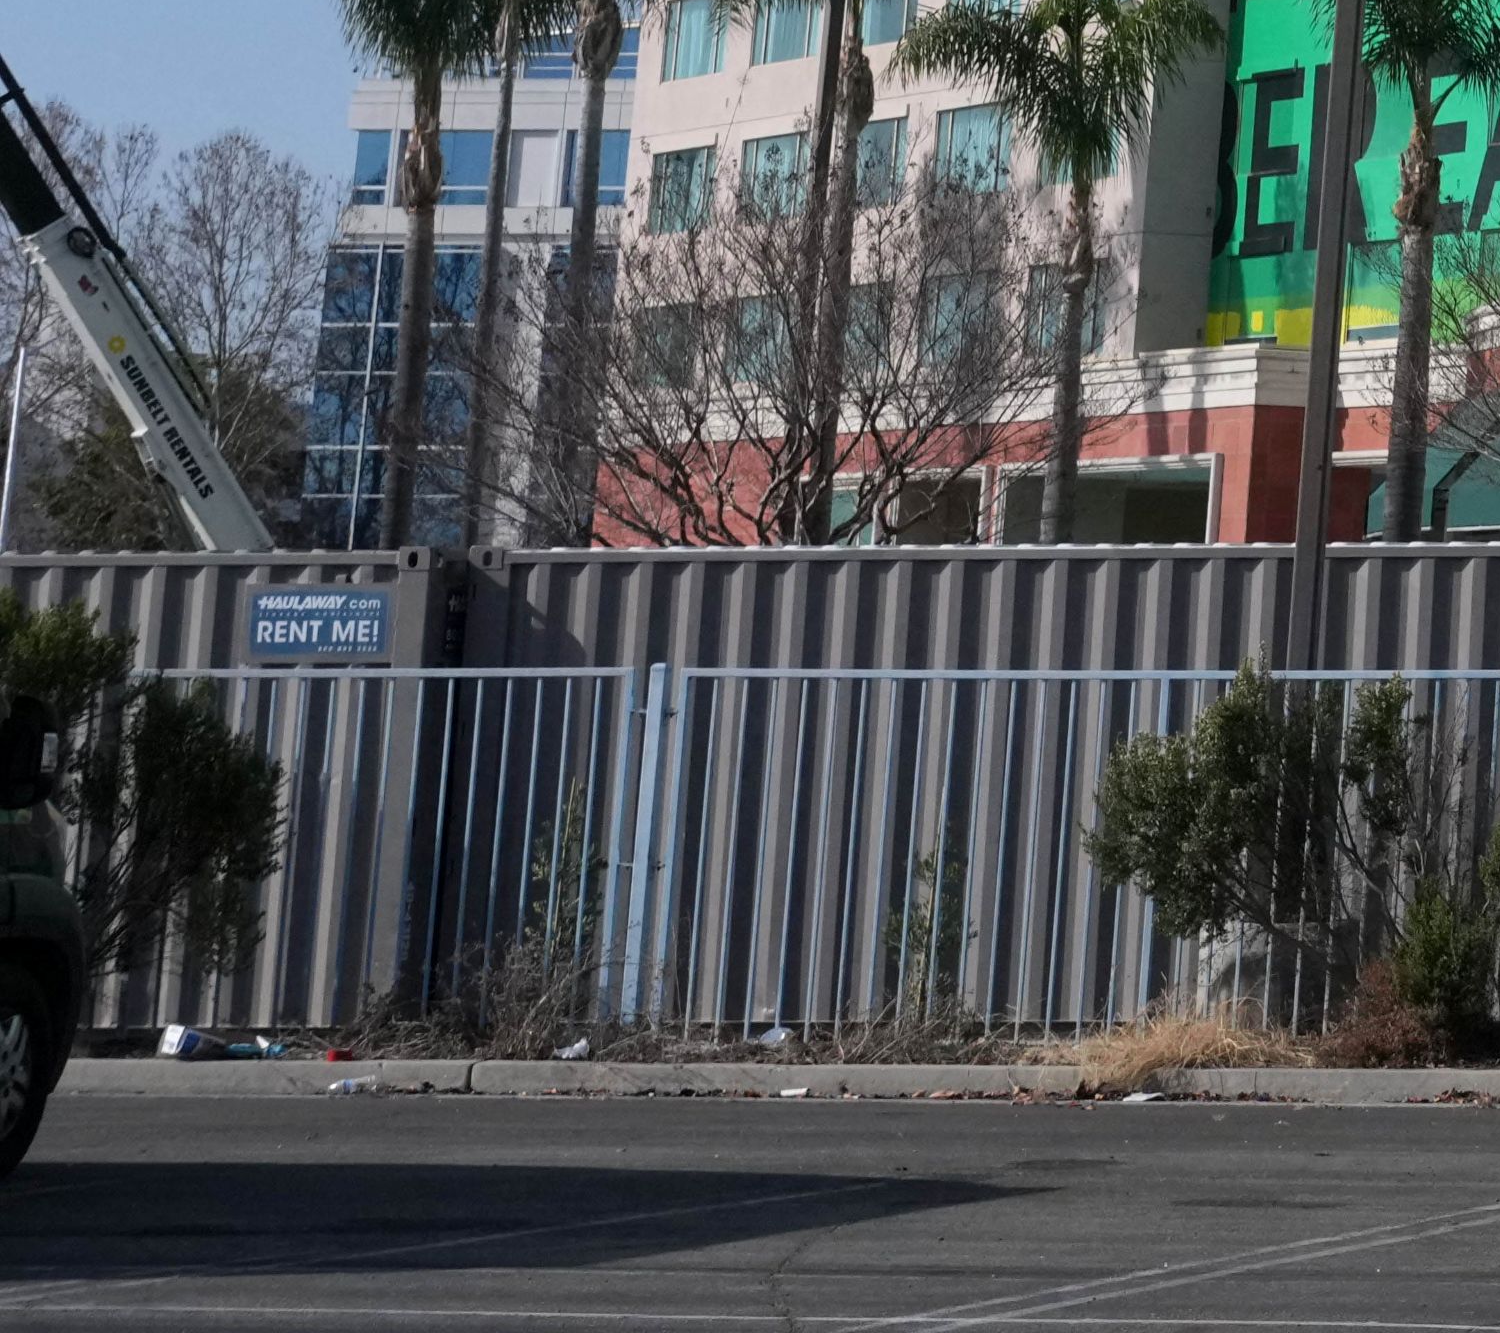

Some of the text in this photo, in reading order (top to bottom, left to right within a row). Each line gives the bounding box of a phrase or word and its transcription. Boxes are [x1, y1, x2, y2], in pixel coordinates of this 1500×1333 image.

[120, 354, 214, 500] SUNBELT RENTALS
[257, 619, 379, 643] RENT ME!
